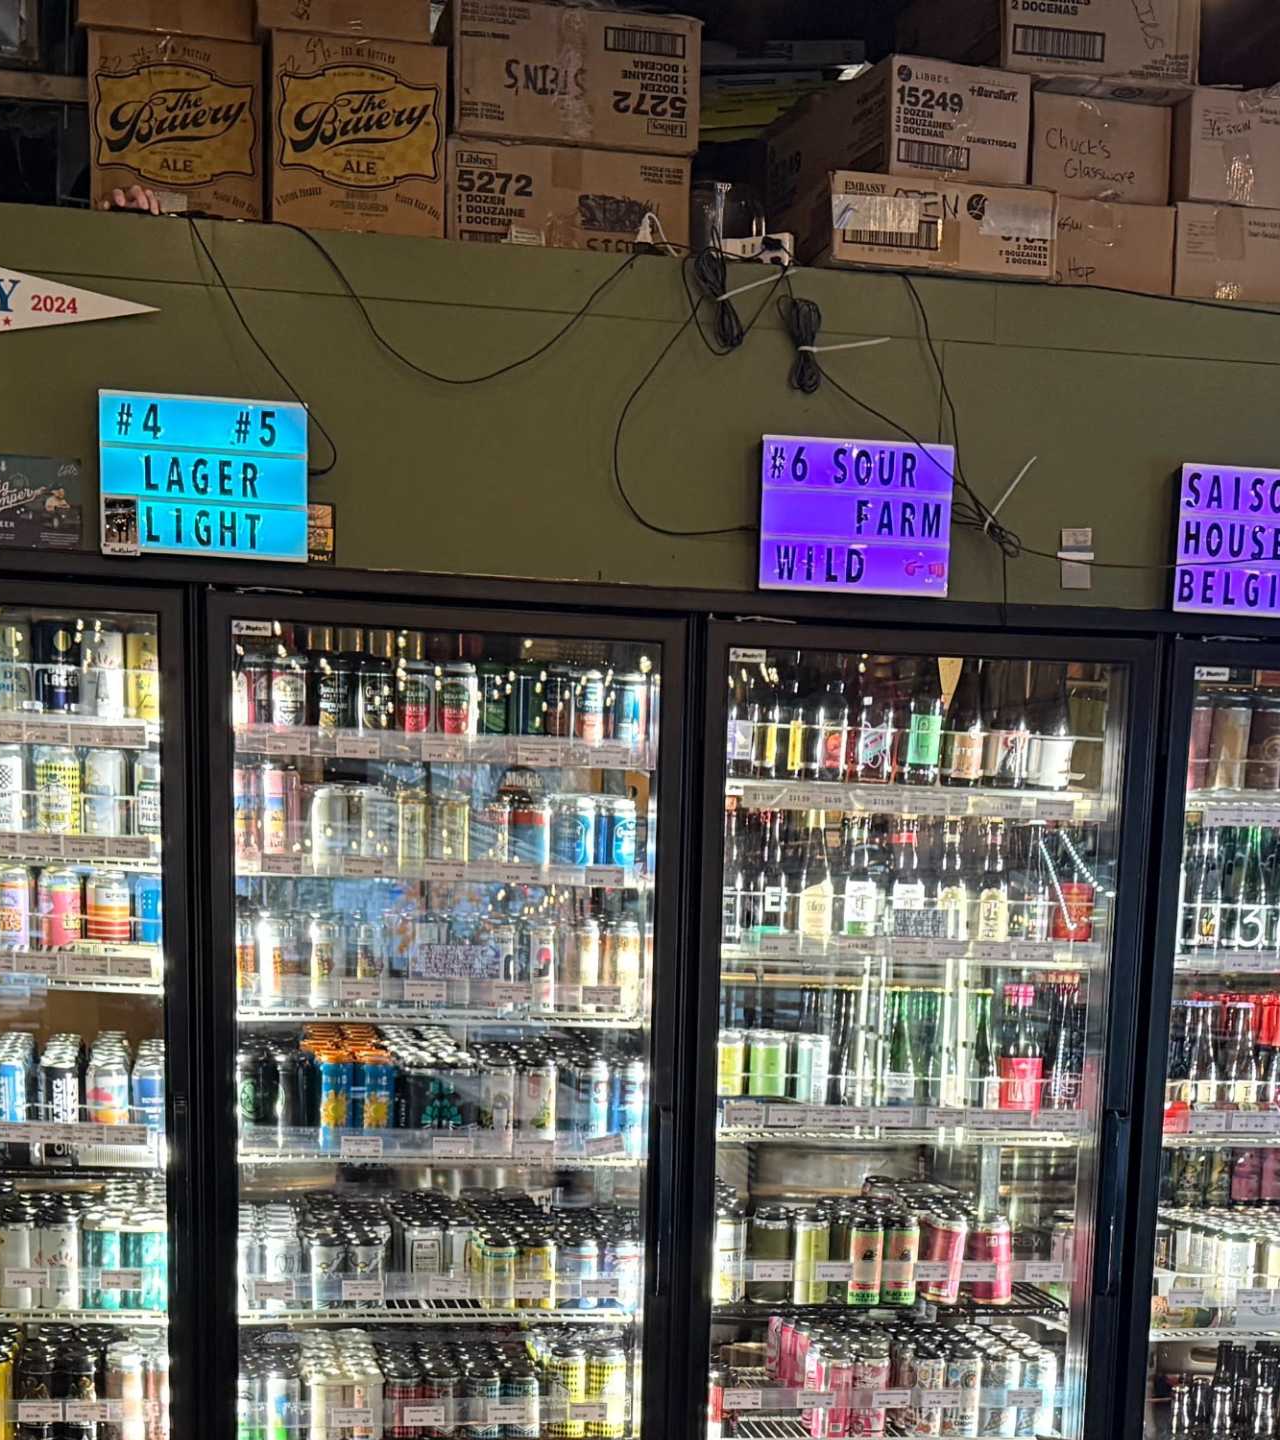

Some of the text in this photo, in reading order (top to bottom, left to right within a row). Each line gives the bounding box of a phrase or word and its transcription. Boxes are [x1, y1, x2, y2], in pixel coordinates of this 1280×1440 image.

[1011, 1, 1078, 15] 2 DOCENAS
[632, 60, 680, 73] DOCENA
[622, 70, 680, 84] DOUZAINE
[640, 82, 680, 94] DOZEN
[167, 91, 203, 114] The
[350, 92, 386, 115] The
[613, 90, 688, 119] 5272
[896, 85, 964, 113] 15249
[903, 108, 934, 119] DOZEN
[649, 121, 685, 134] Libbey
[903, 117, 954, 130] DOUZAINES
[903, 125, 944, 138] DOCENAS
[1045, 127, 1111, 159] Chuck's
[159, 158, 193, 173] ALE
[343, 159, 376, 175] ALE
[459, 154, 493, 166] Libbey
[1064, 158, 1135, 184] Glassware
[457, 170, 533, 197] 5272
[845, 180, 886, 193] EMBASSY
[466, 194, 505, 205] DOZEN
[466, 205, 525, 218] DOUZAINE
[30, 294, 78, 315] 2024
[833, 447, 917, 488] SOUR
[143, 454, 260, 498] LAGER
[856, 500, 941, 538] FARM
[144, 505, 261, 550] LIGHT
[776, 545, 865, 583] WILD
[506, 772, 544, 787] Modelo
